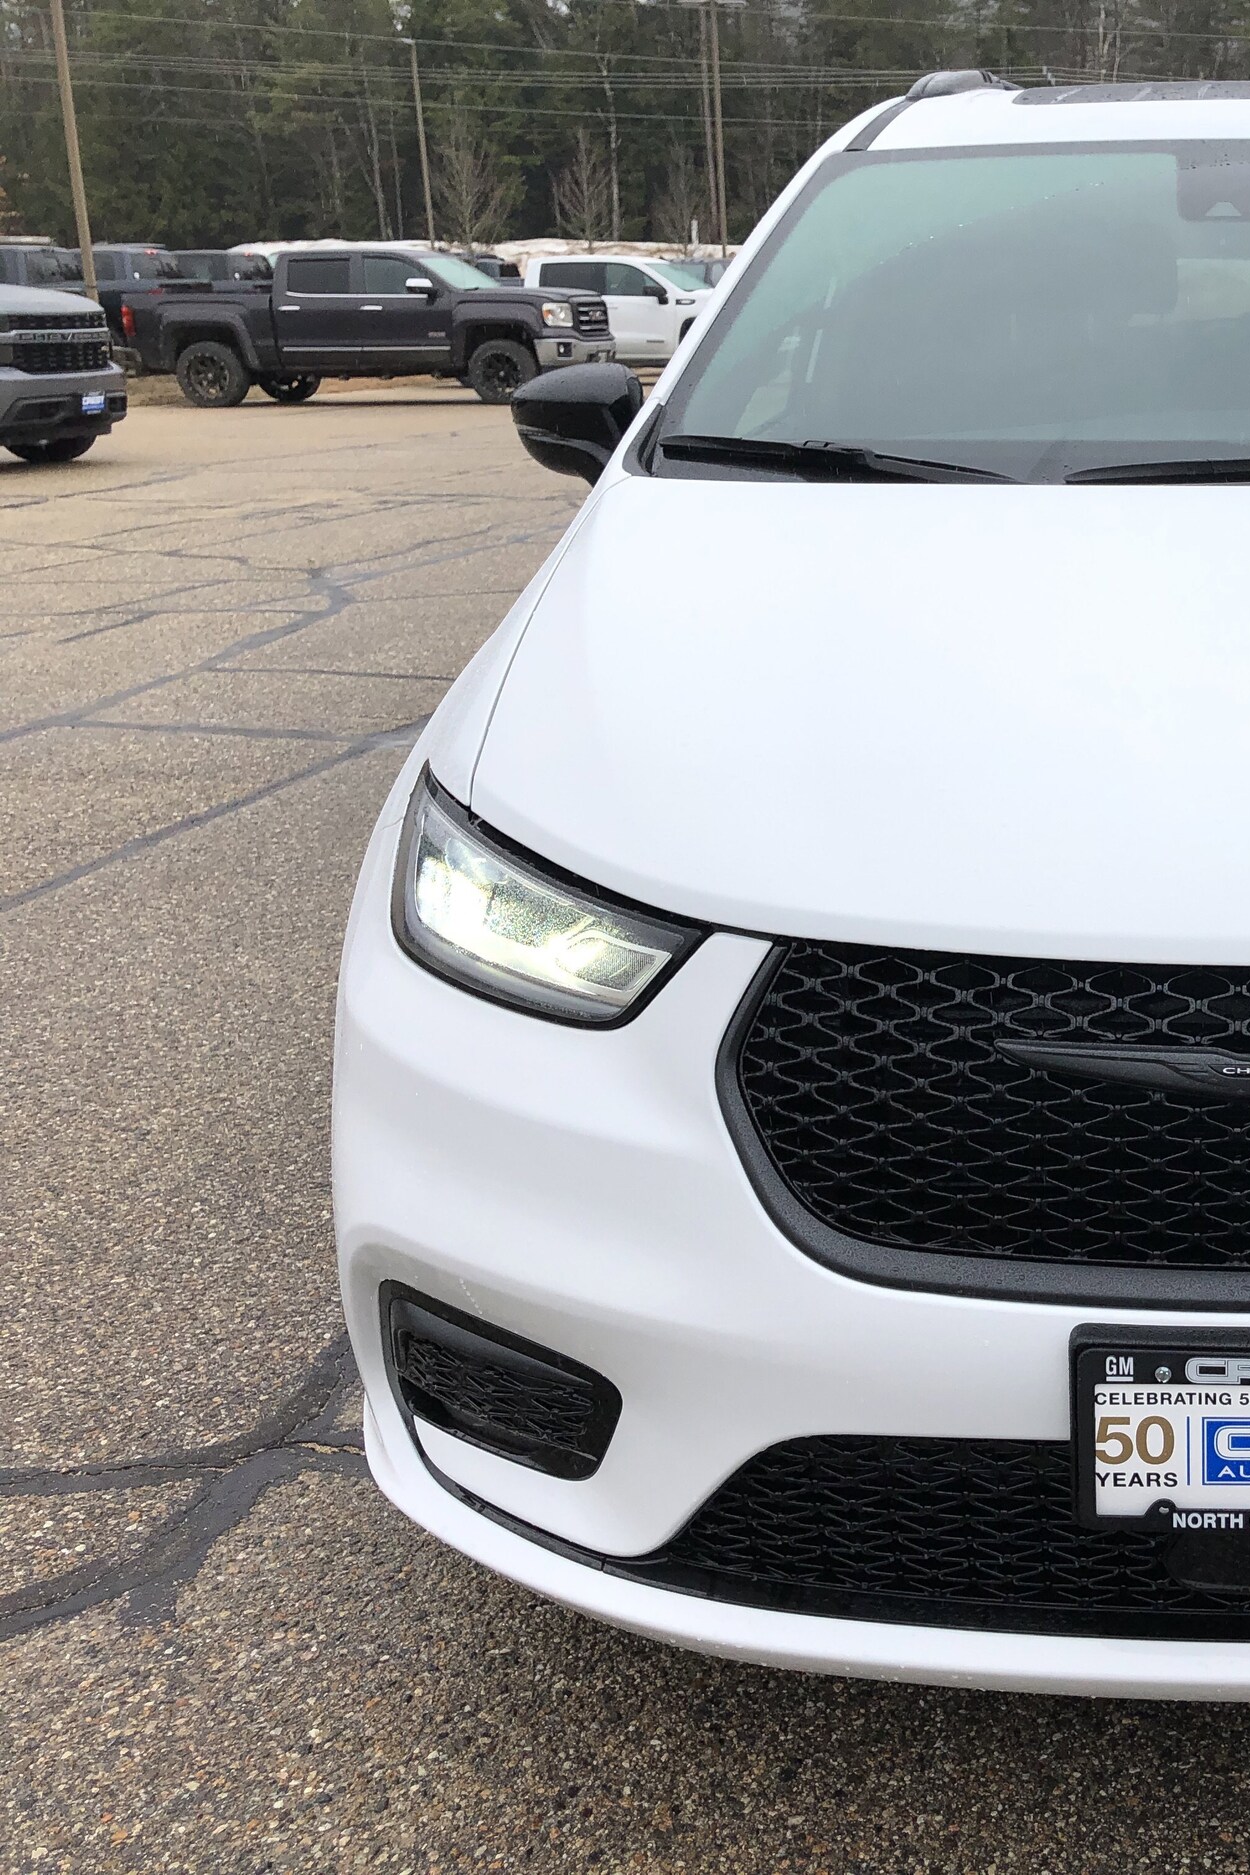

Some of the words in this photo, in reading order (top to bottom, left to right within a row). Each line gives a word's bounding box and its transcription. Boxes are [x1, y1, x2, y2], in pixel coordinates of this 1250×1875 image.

[1105, 1355, 1134, 1375] GM
[1094, 1392, 1232, 1405] CELEBRATING
[1096, 1415, 1175, 1465] 50
[1095, 1472, 1178, 1487] YEARS
[1172, 1513, 1243, 1528] NORTH
